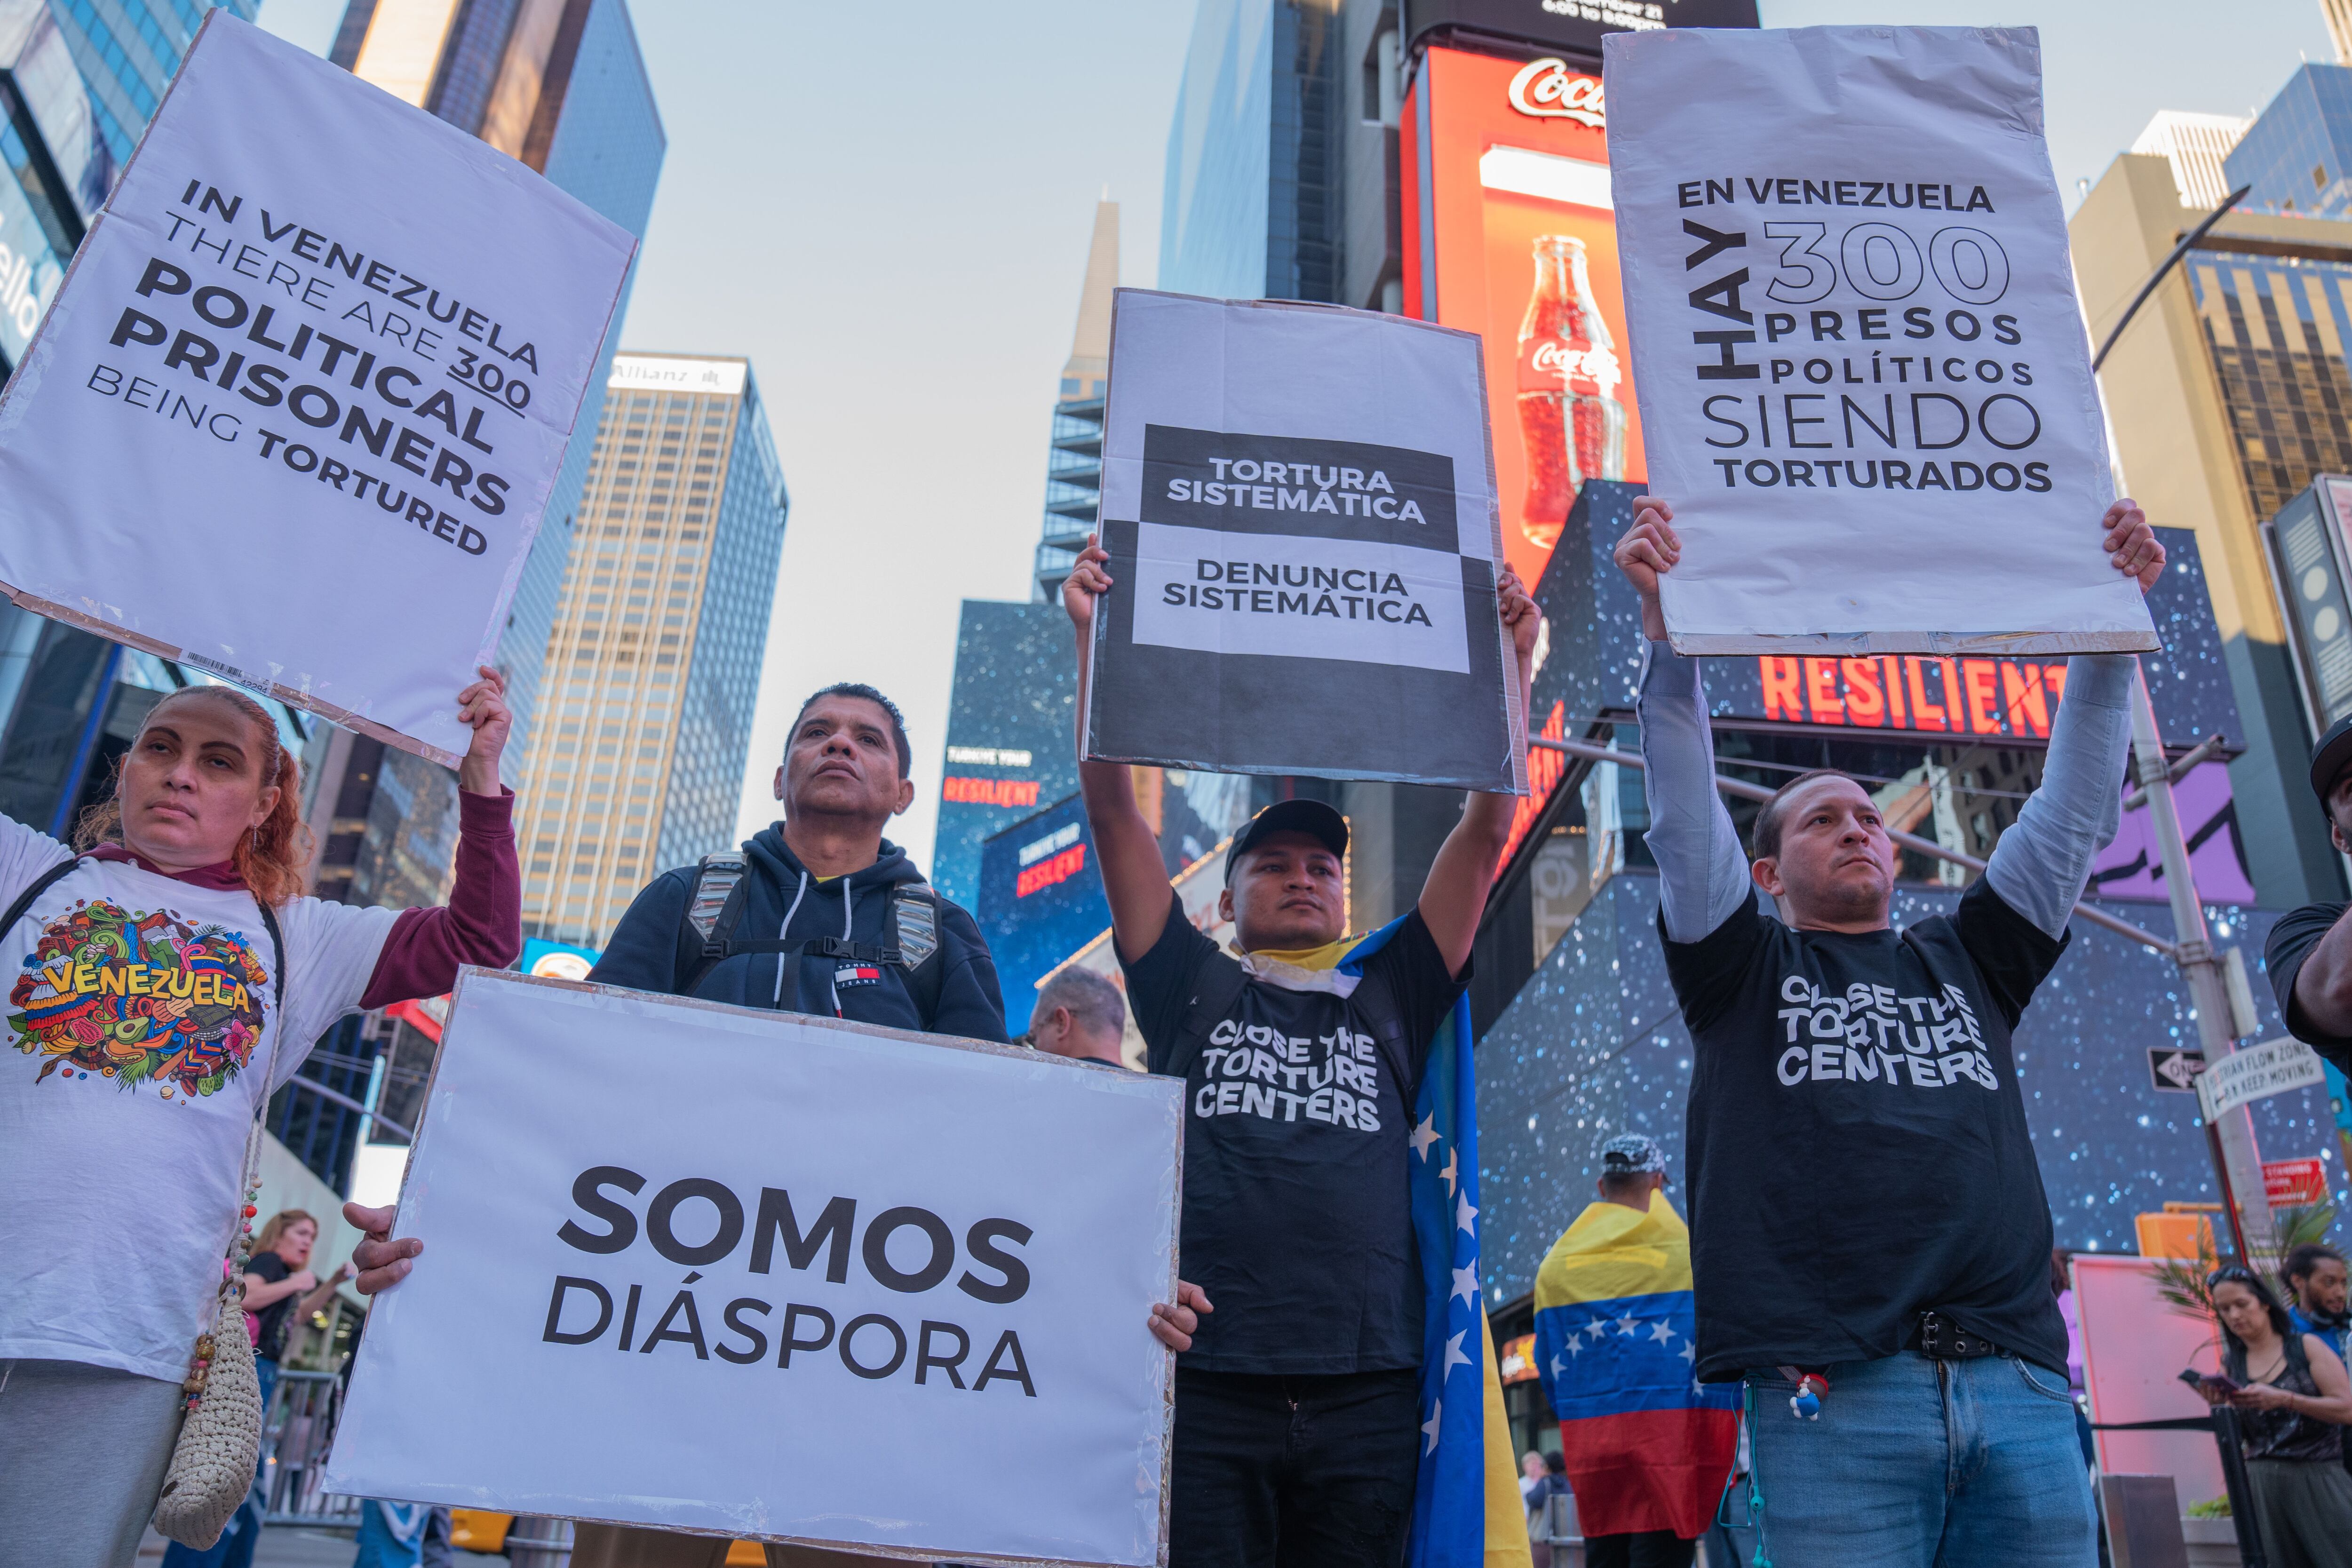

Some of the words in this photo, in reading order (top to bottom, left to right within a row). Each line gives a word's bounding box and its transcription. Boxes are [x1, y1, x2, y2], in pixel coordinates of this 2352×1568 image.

[1580, 4, 1601, 21] to
[1678, 178, 1734, 208] EN
[1745, 178, 1995, 213] VENEZUELA
[181, 179, 243, 223] IN
[261, 209, 538, 376] VENEZUELA
[1764, 222, 2010, 305] 300
[166, 211, 335, 311] THERE
[341, 301, 443, 362] ARE
[447, 346, 531, 414] 300
[1683, 218, 1760, 380] HAY
[1764, 307, 2021, 345] PRESOS
[135, 257, 493, 455] POLITICAL
[613, 365, 687, 382] Allianz
[1771, 350, 2033, 386] POLÍTICOS
[109, 307, 510, 515] PRISONERS
[1702, 393, 2041, 450] SIENDO
[87, 364, 242, 442] BEING
[258, 428, 487, 555] TORTURED
[1208, 457, 1395, 493] TORTURA
[1713, 459, 2052, 493] TORTURADOS
[1167, 478, 1427, 525] SISTEMÁTICA
[1197, 559, 1409, 597] DENUNCIA
[1162, 583, 1433, 628] SISTEMÁTICA
[943, 777, 1040, 808] RESILIENT
[42, 961, 251, 1013] VENEZUELA
[842, 979, 876, 987] JEANS
[1898, 983, 1973, 1021] THE
[1209, 1019, 1311, 1063] CLOSE
[1319, 1026, 1376, 1063] THE
[1778, 1008, 1987, 1054] TORTURE
[1202, 1047, 1379, 1098] TORTURE
[1777, 1044, 1998, 1090] CENTERS
[2241, 1073, 2265, 1095] KEEP
[2269, 1059, 2314, 1086] MOVING
[2245, 1050, 2274, 1071] FLOW
[2279, 1043, 2309, 1062] ZONE
[1195, 1082, 1381, 1132] CENTERS
[556, 1166, 1034, 1304] SOMOS
[542, 1270, 1038, 1397] DIÁSPORA
